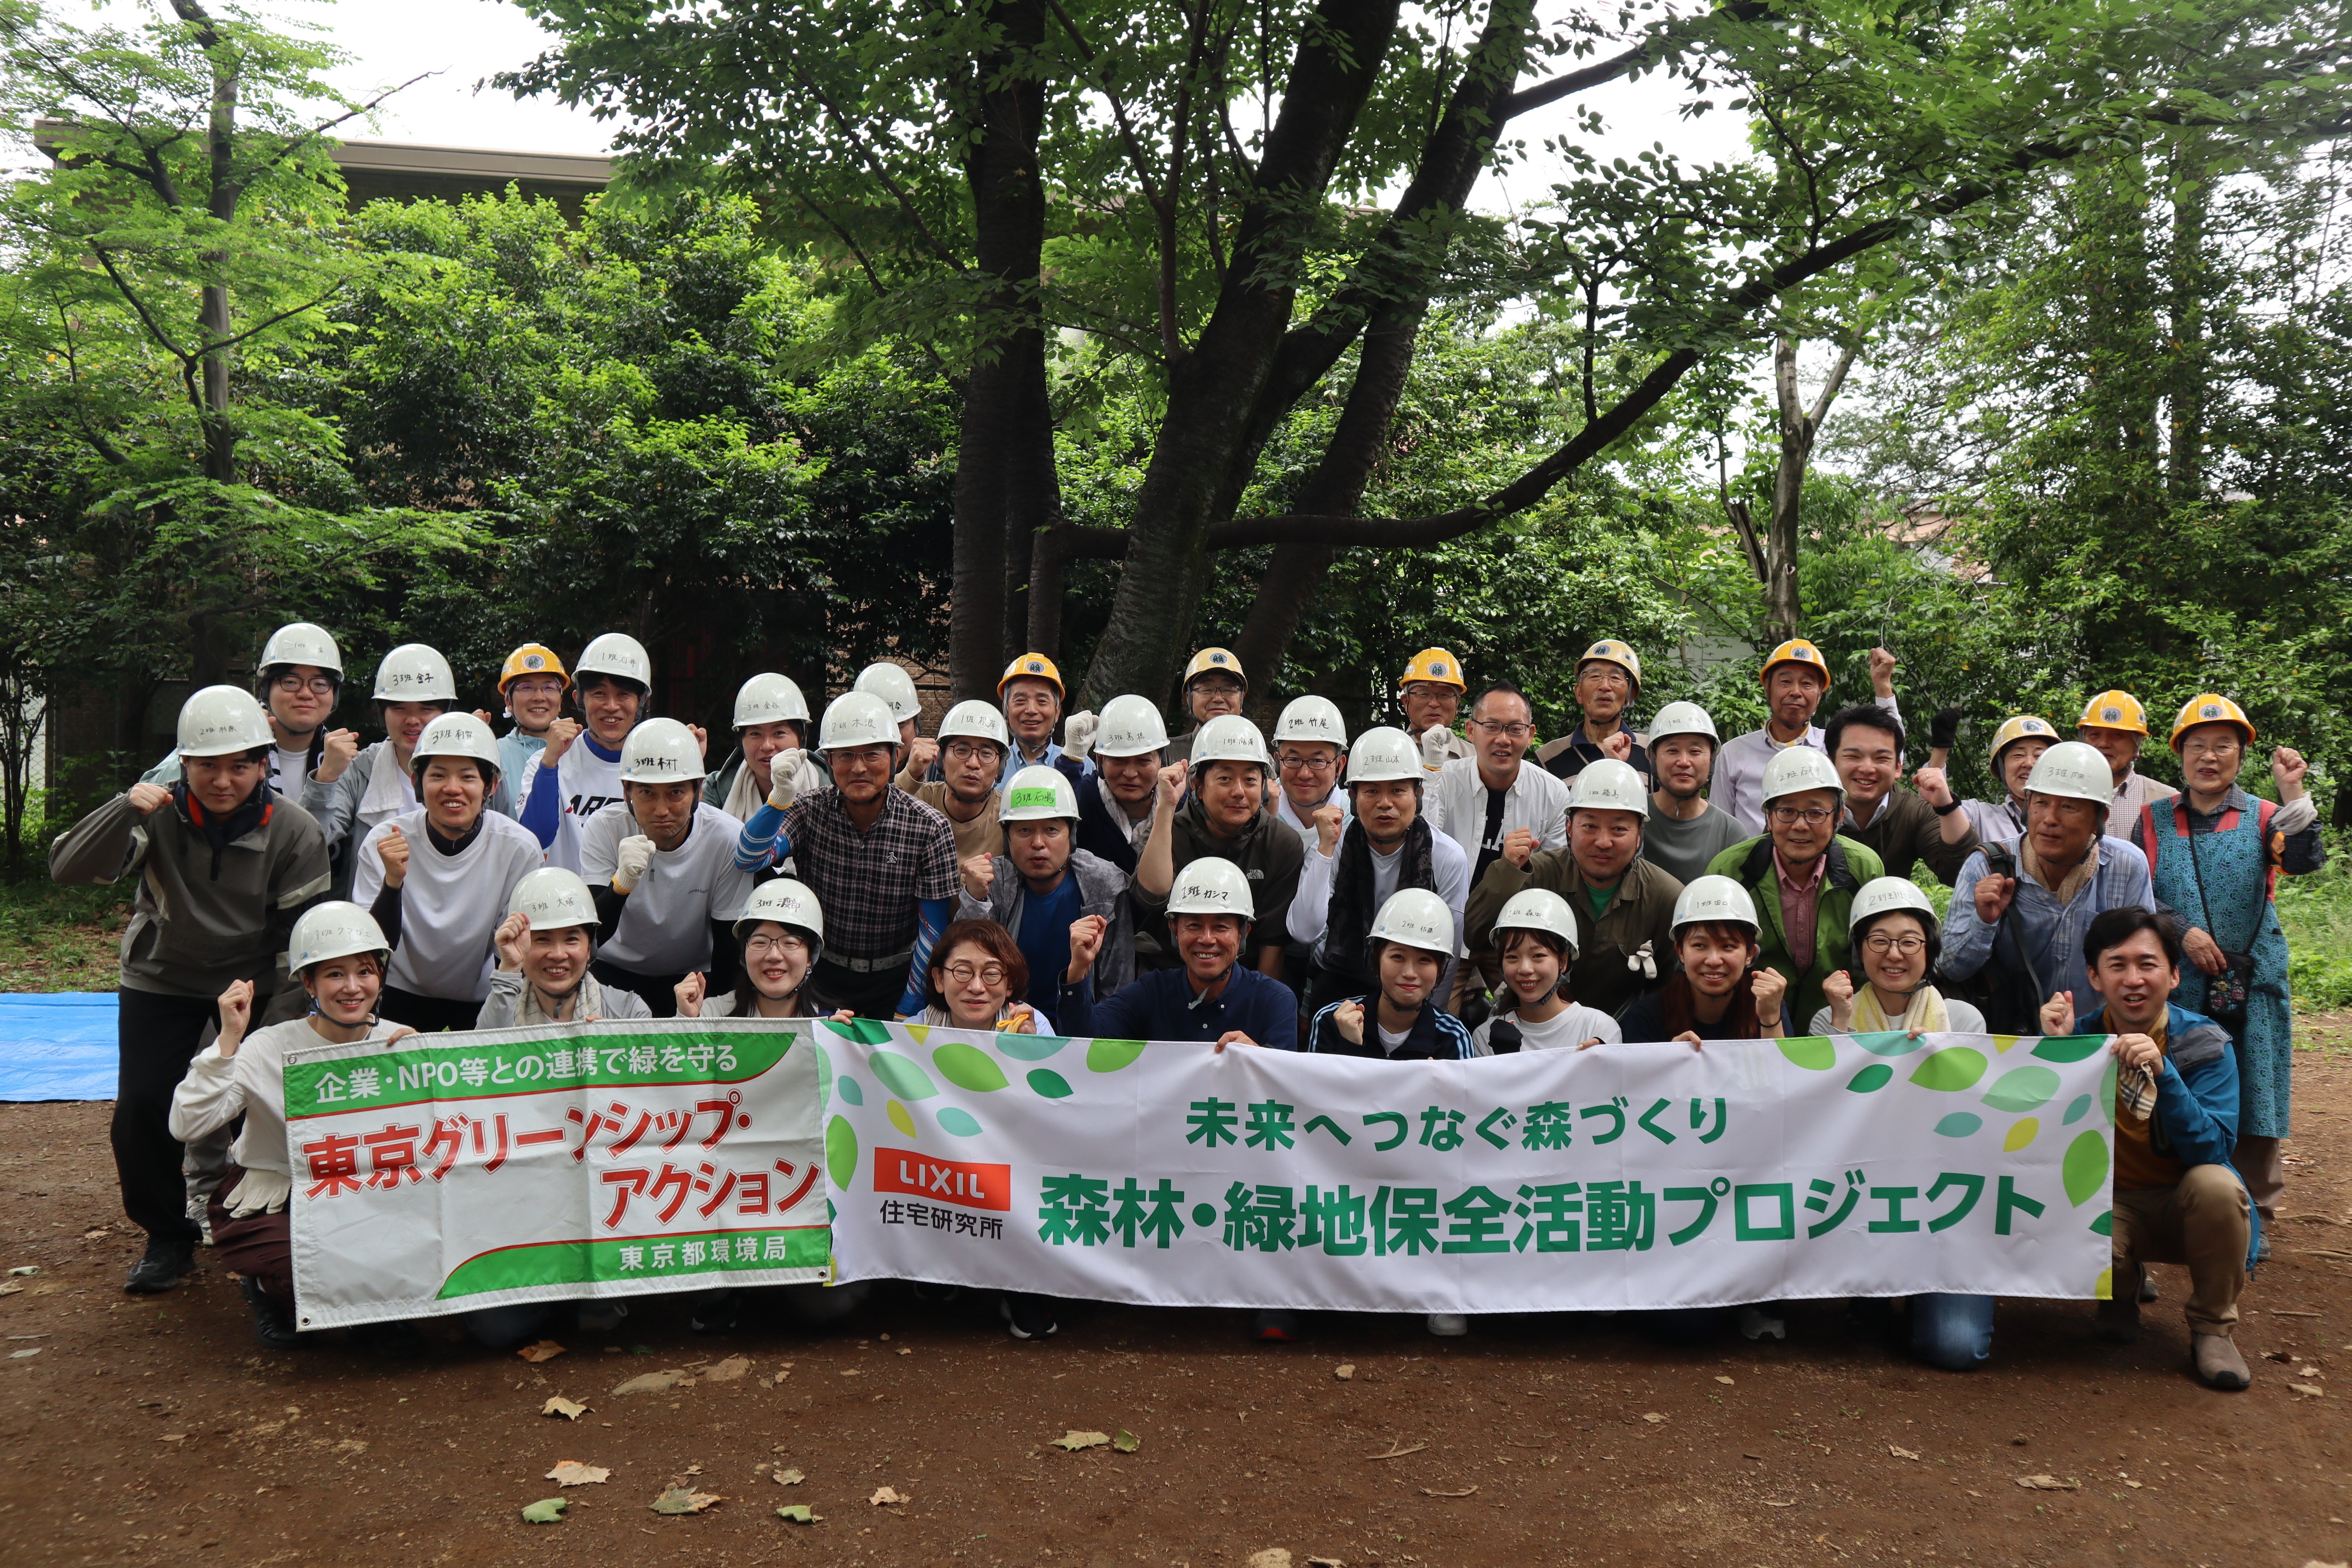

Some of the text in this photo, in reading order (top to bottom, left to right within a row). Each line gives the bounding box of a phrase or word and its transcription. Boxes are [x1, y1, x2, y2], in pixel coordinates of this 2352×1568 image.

[602, 652, 636, 667] 1班 酒井
[392, 673, 434, 686] 3班 金子
[763, 701, 780, 709] 金谷
[832, 722, 847, 732] 2班
[961, 715, 996, 729] 1班 根岸
[1289, 717, 1329, 729] 2班 竹尾
[1668, 719, 1681, 727] 1班
[200, 727, 215, 735] 2班
[431, 729, 472, 744] 3班 有賀
[634, 757, 655, 767] 3班
[1364, 754, 1400, 765] 2班 山本
[1780, 771, 1798, 781] 2班
[2047, 767, 2068, 777] 3班
[1015, 793, 1032, 804] 3班
[1181, 886, 1229, 901] 1班 カシマ
[1869, 893, 1895, 906] 2班
[532, 897, 575, 913] 3班 大塚
[756, 897, 800, 913] 3班 渡部
[1697, 900, 1712, 909] 1班
[314, 1044, 738, 1104] 企業・NPO等との連携で緑を守る
[1186, 1097, 1726, 1152] 未来へつなぐ森づくり
[300, 1087, 753, 1201] 東京グリーンシップ・
[899, 1160, 985, 1200] LIXIL
[600, 1157, 822, 1229] アクション
[879, 1200, 1004, 1240] 住宅研究所
[1038, 1169, 2045, 1257] 森林・緑地保全活動プロジェクト
[619, 1235, 787, 1272] 東京都環境局
